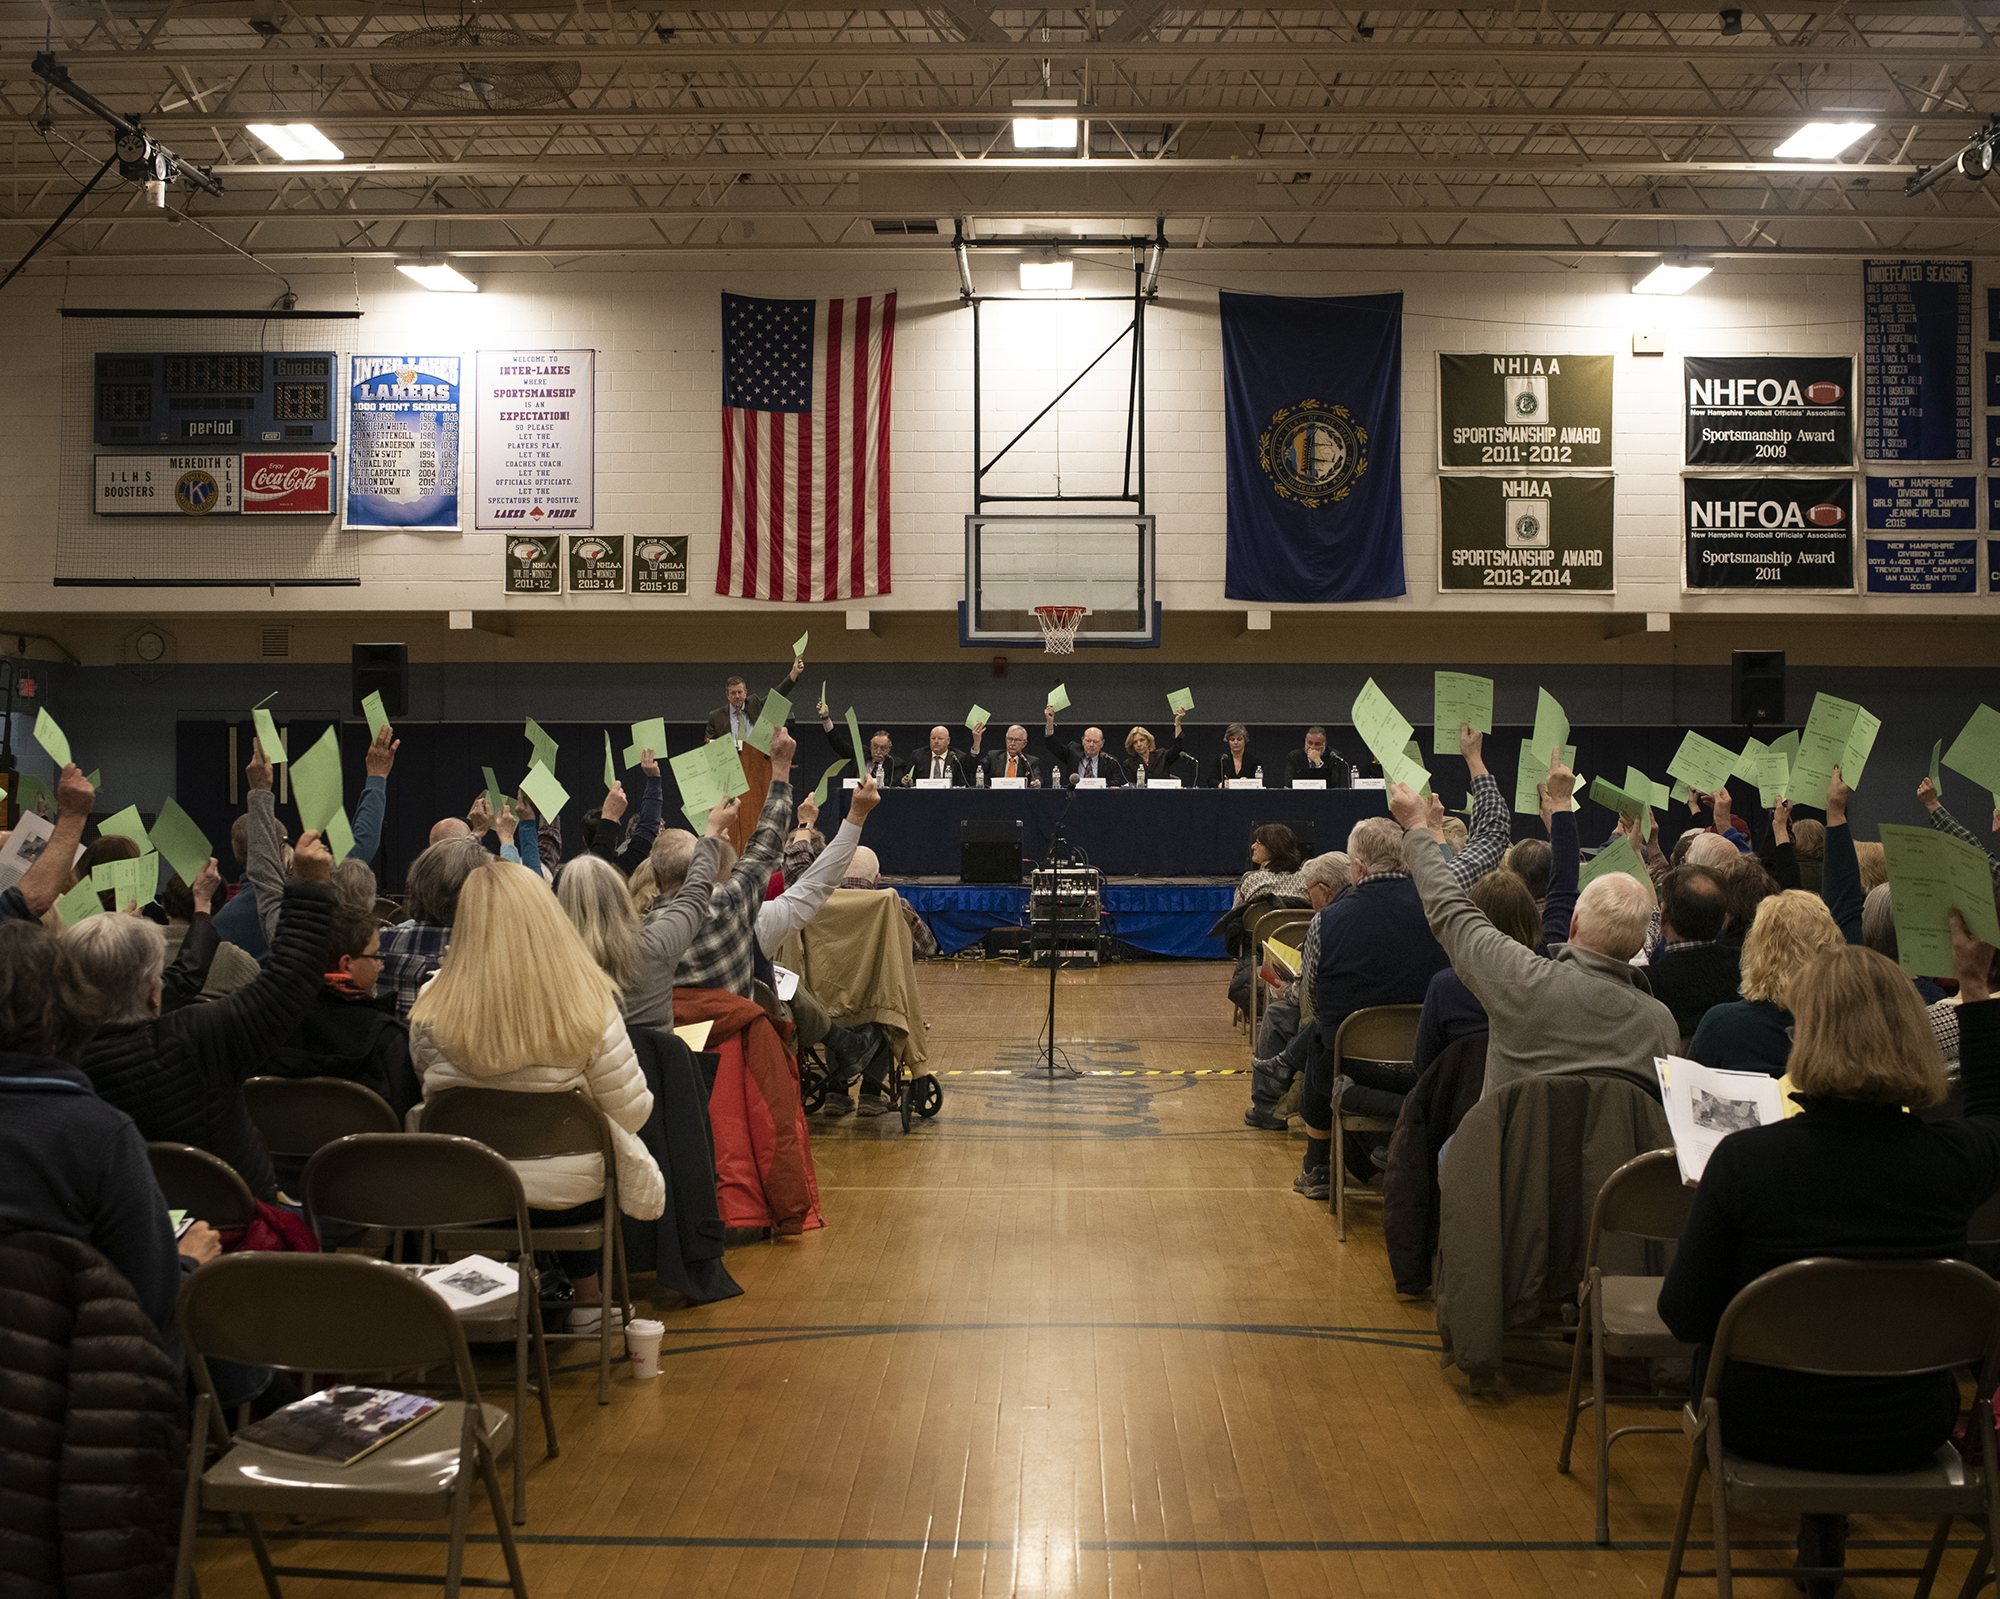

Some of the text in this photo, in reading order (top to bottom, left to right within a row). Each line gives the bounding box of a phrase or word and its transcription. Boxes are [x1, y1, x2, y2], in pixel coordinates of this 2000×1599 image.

[1867, 266, 1968, 283] UNDEFEATED SEASONS
[277, 360, 325, 375] Guests
[500, 366, 570, 375] INTER-LAKES
[1493, 358, 1560, 375] NHIAA
[361, 384, 450, 401] LAKERS
[494, 389, 576, 398] SPORTSMANSHIP
[1690, 378, 1804, 406] NHFOA
[354, 403, 457, 411] 1000 POINT SCORERS
[353, 412, 366, 420] TOM
[420, 412, 436, 420] 1967
[500, 412, 570, 421] EXPECTATION!
[1708, 409, 1743, 417] Hampshire
[190, 420, 233, 437] period
[353, 422, 457, 430] PATRICIA WHITE 1973 1014
[352, 432, 370, 440] JOAN
[372, 432, 413, 440] PETTENGILL
[420, 432, 436, 440] 1980
[1453, 427, 1600, 444] SPORTSMANSHIP AWARD
[1703, 428, 1835, 444] Sportsmanship Award
[352, 441, 457, 449] BRUCE SANDERSON 1983 1047
[1482, 446, 1572, 462] 2011-2012
[1755, 445, 1787, 458] 2009
[170, 458, 220, 468] MEREDITH
[352, 460, 456, 468] MICHAEL ROY 1996 1335
[352, 469, 456, 477] JEFF CARPENTER 2004 1174
[352, 478, 456, 486] DILLON DOW 2015 1026
[1889, 479, 1953, 488] NEW HAMPSHIRE
[104, 486, 154, 498] BOOSTERS
[1502, 480, 1552, 497] NHIAA
[1898, 489, 1944, 498] DIVISION III
[1873, 499, 1969, 508] GIRLS HIGH JUMP CHAMPION
[494, 509, 577, 518] LAKER PRIDE
[1691, 501, 1806, 528] NHFOA
[1889, 509, 1951, 517] JEANNE PUGLISI
[1886, 519, 1906, 528] 2015
[1708, 532, 1744, 540] Hampshire
[1452, 550, 1602, 566] SPORTSMANSHIP AWARD
[1703, 550, 1835, 566] Sportsmanship Award
[1483, 569, 1571, 586] 2013-2014
[1755, 567, 1781, 580] 2011
[515, 580, 550, 588] 2011-12
[578, 580, 614, 588] 2013-14
[640, 582, 678, 591] 2015-16
